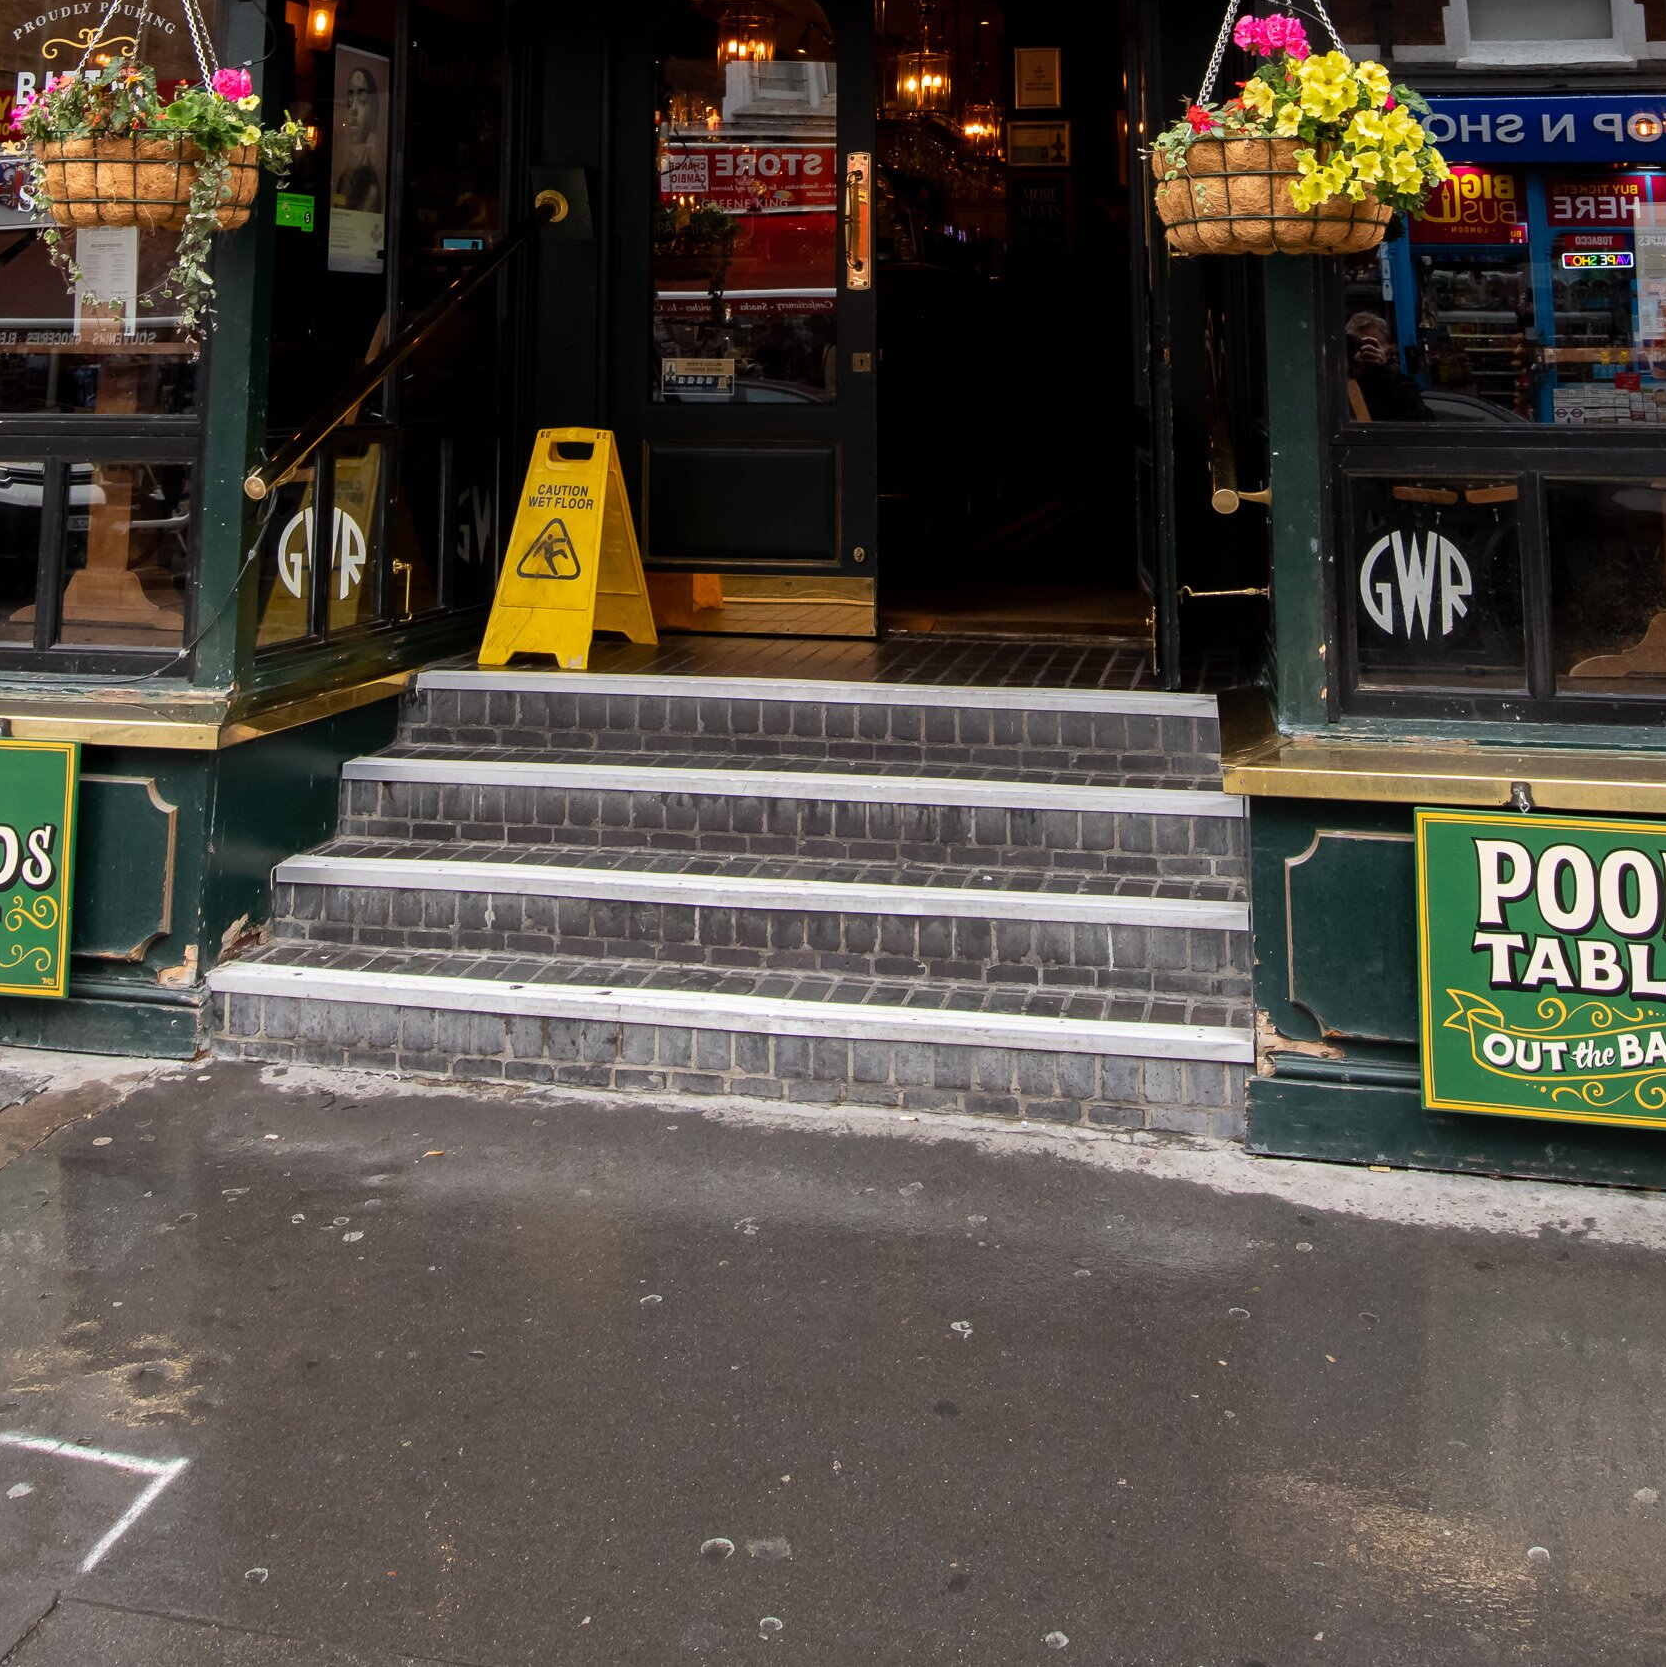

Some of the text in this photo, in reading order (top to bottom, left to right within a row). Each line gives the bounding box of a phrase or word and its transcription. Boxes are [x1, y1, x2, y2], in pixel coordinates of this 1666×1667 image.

[12, 2, 93, 41] PROUDLY
[701, 198, 789, 209] GREENE KING
[528, 496, 594, 510] WET FLOOR
[537, 484, 589, 497] CAUTION
[1359, 530, 1473, 640] GWR
[1482, 1031, 1570, 1074] OUT
[1569, 1038, 1617, 1069] the
